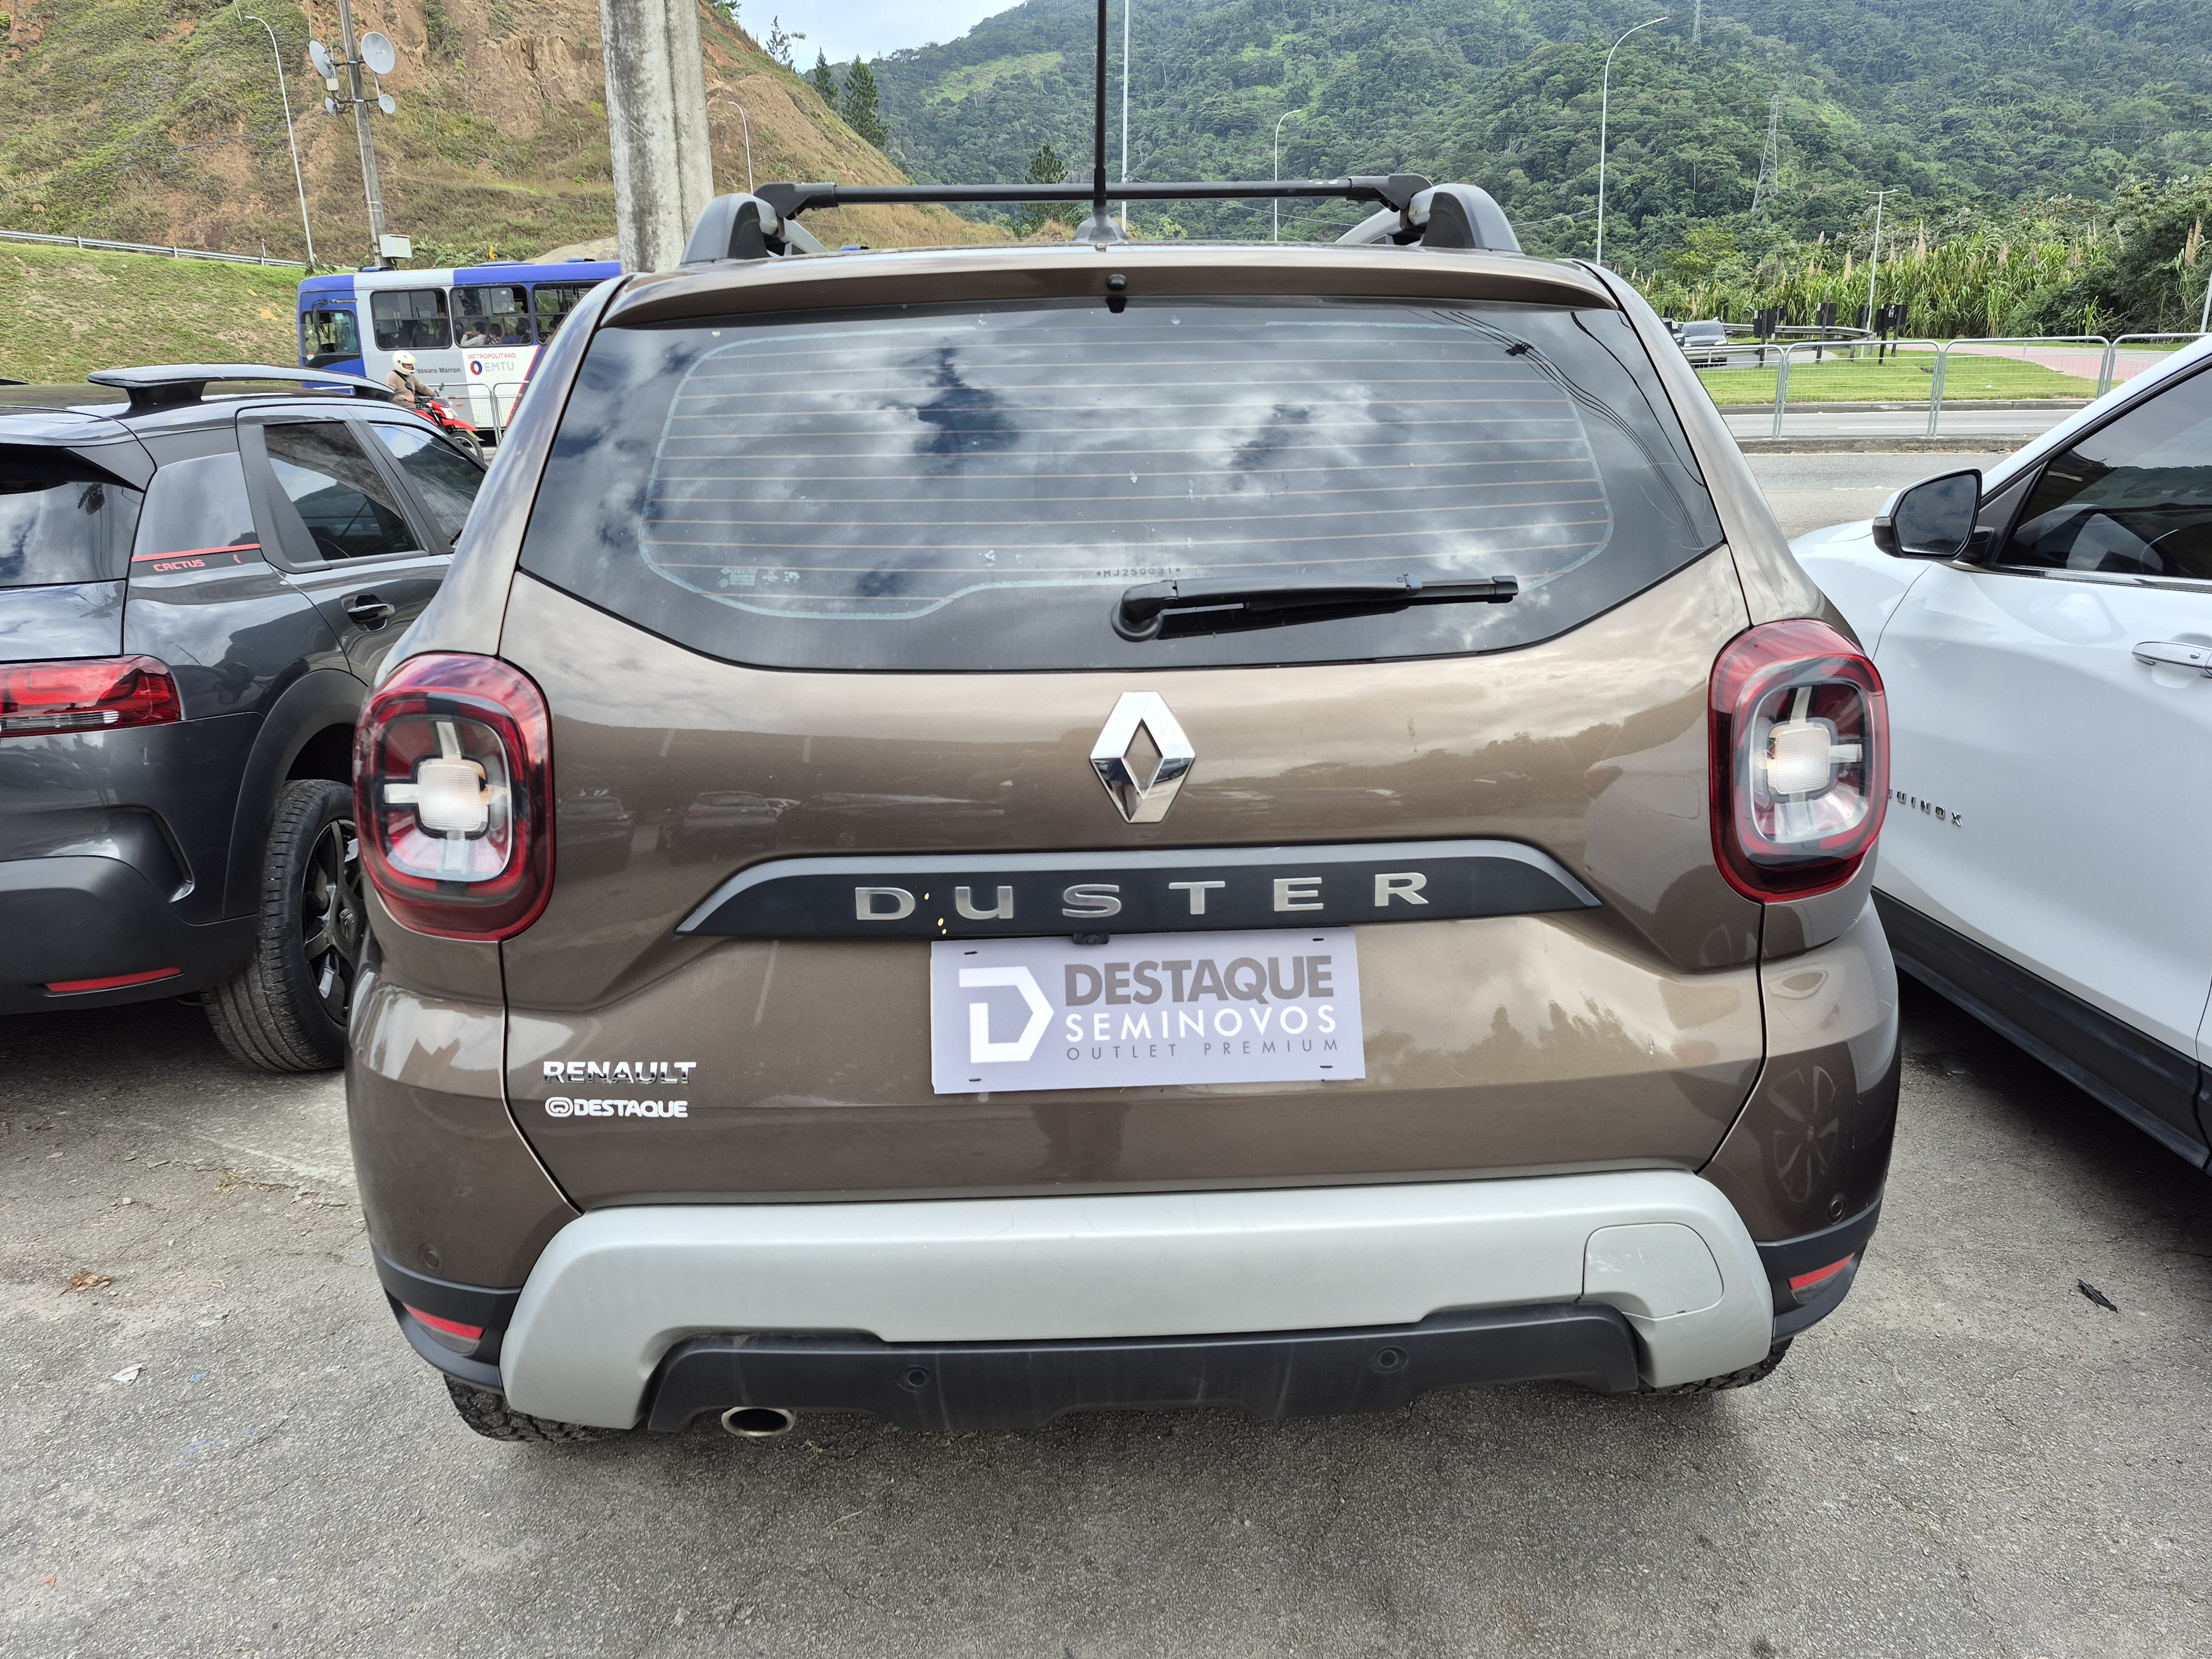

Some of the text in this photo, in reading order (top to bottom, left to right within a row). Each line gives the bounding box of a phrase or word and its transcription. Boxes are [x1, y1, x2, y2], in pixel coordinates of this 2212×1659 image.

[484, 361, 514, 372] EMTU
[153, 559, 206, 572] CACTUS
[855, 872, 1430, 920] DUSTER
[1065, 955, 1334, 1006] DESTAQUE
[1065, 1004, 1336, 1042] SEMINOVOS
[1067, 1039, 1338, 1060] OUTLET PREMIUM
[543, 1061, 697, 1084] RENAULT
